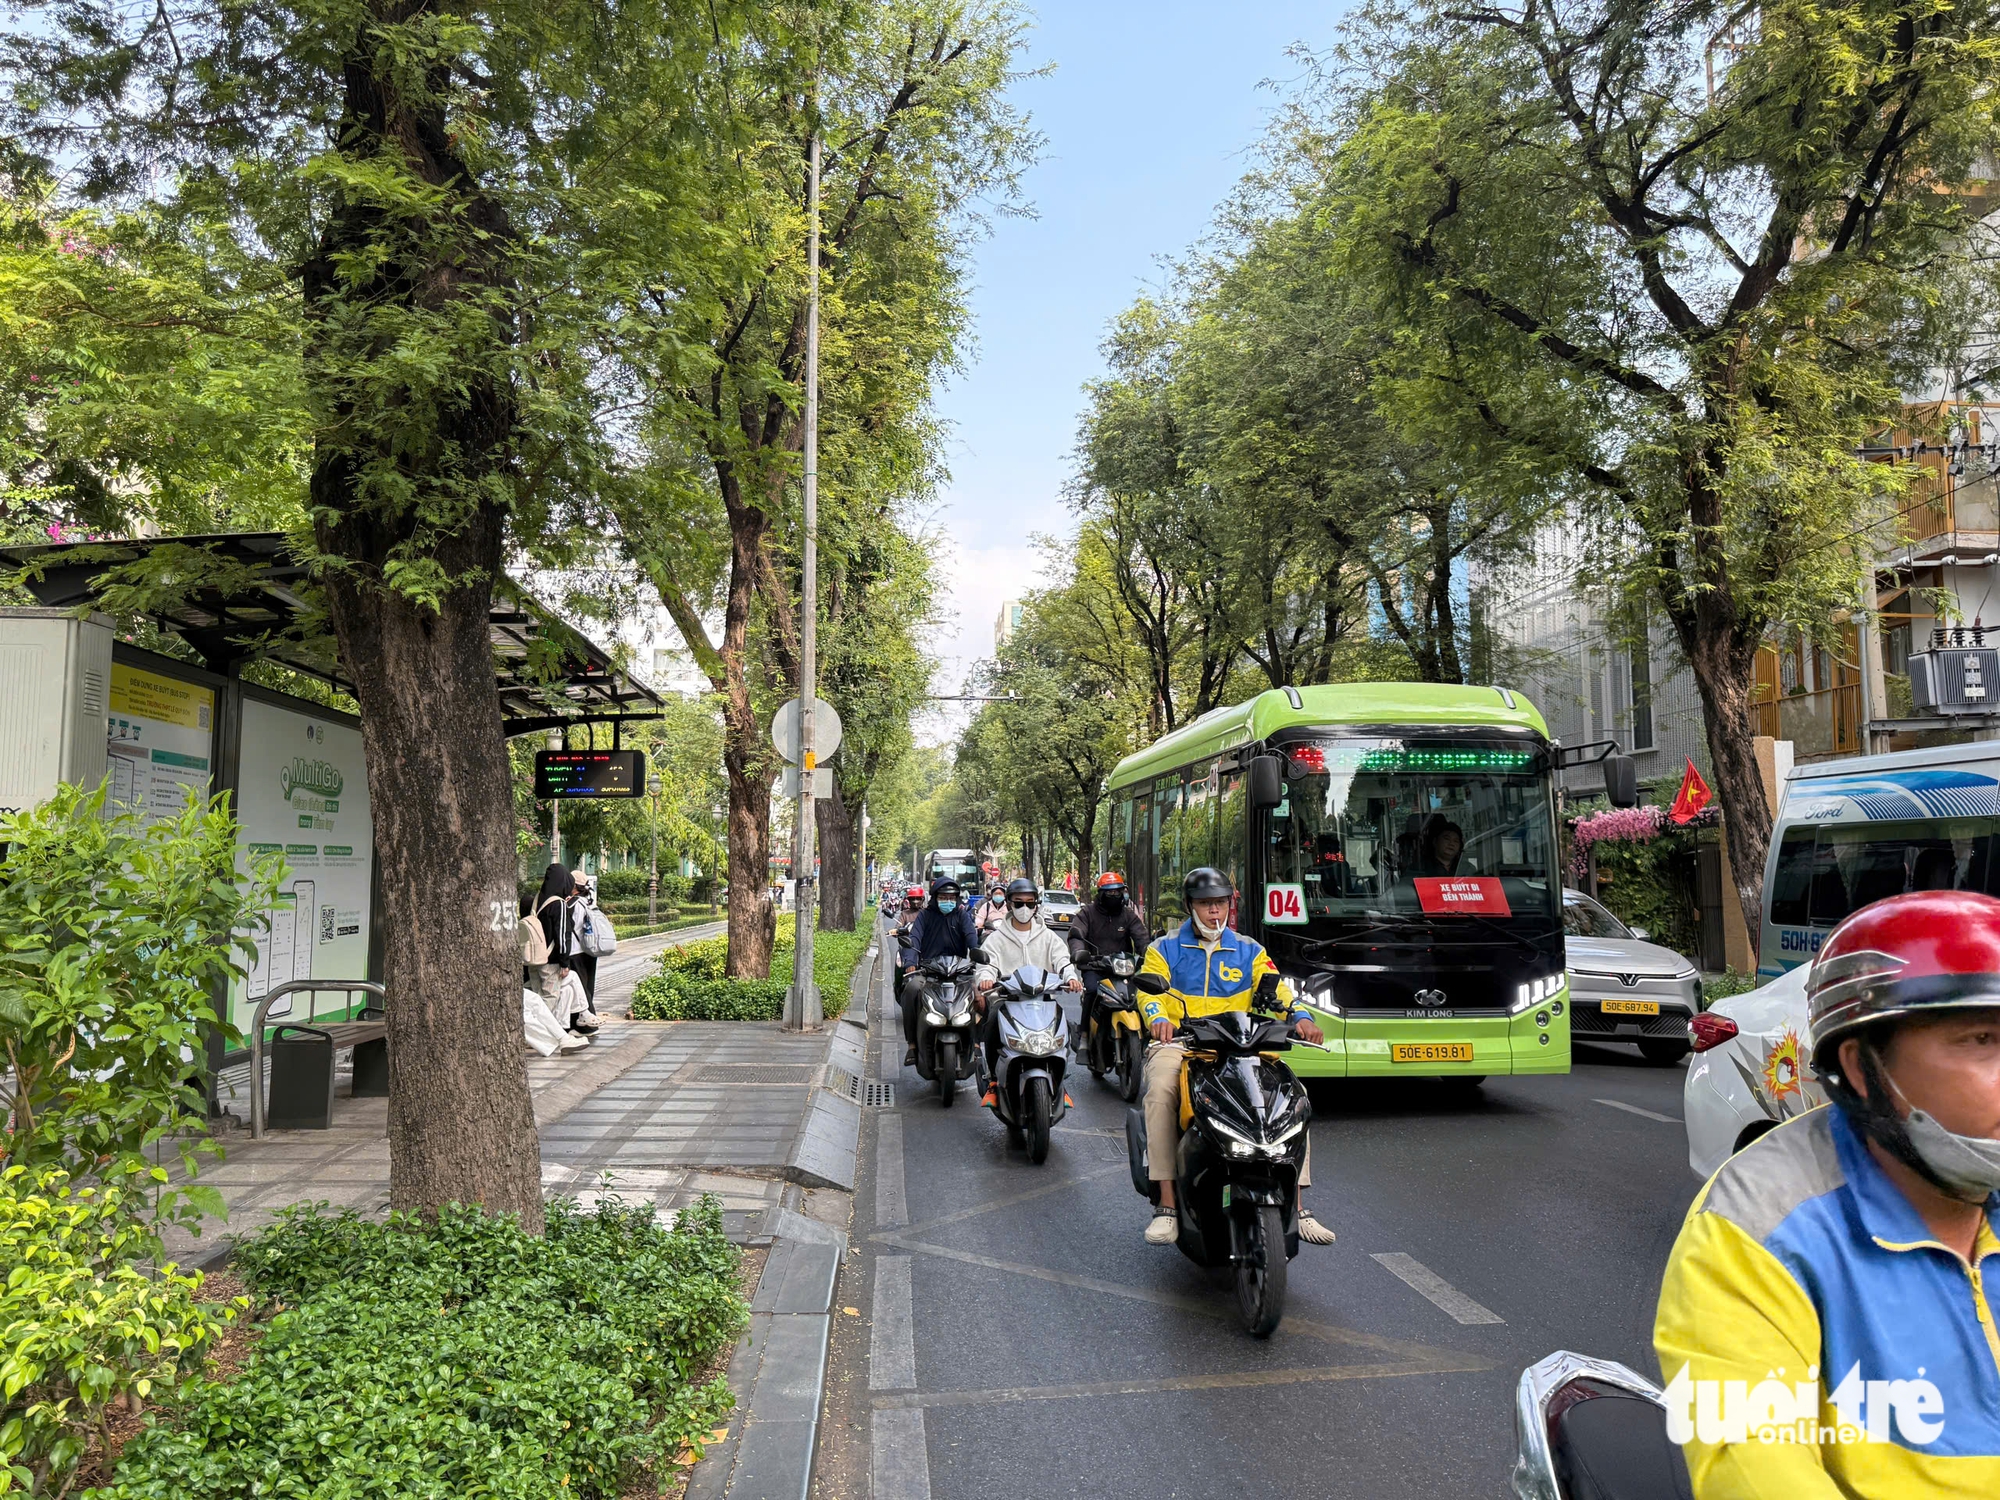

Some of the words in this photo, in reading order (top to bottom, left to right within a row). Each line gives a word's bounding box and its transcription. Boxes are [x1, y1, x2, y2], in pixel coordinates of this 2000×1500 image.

[293, 758, 340, 790] MultiGo
[1804, 802, 1845, 820] Ford
[1439, 883, 1451, 892] XE
[1451, 881, 1470, 892] BUÝT
[1442, 892, 1459, 901] BẾN
[1459, 892, 1484, 901] THÀNH
[1268, 889, 1301, 918] 04
[1219, 961, 1243, 983] be
[1406, 1009, 1425, 1018] KIM
[1428, 1009, 1453, 1018] LONG
[1606, 1002, 1654, 1012] 50E-687.94
[1399, 1046, 1465, 1059] 50E-619.81
